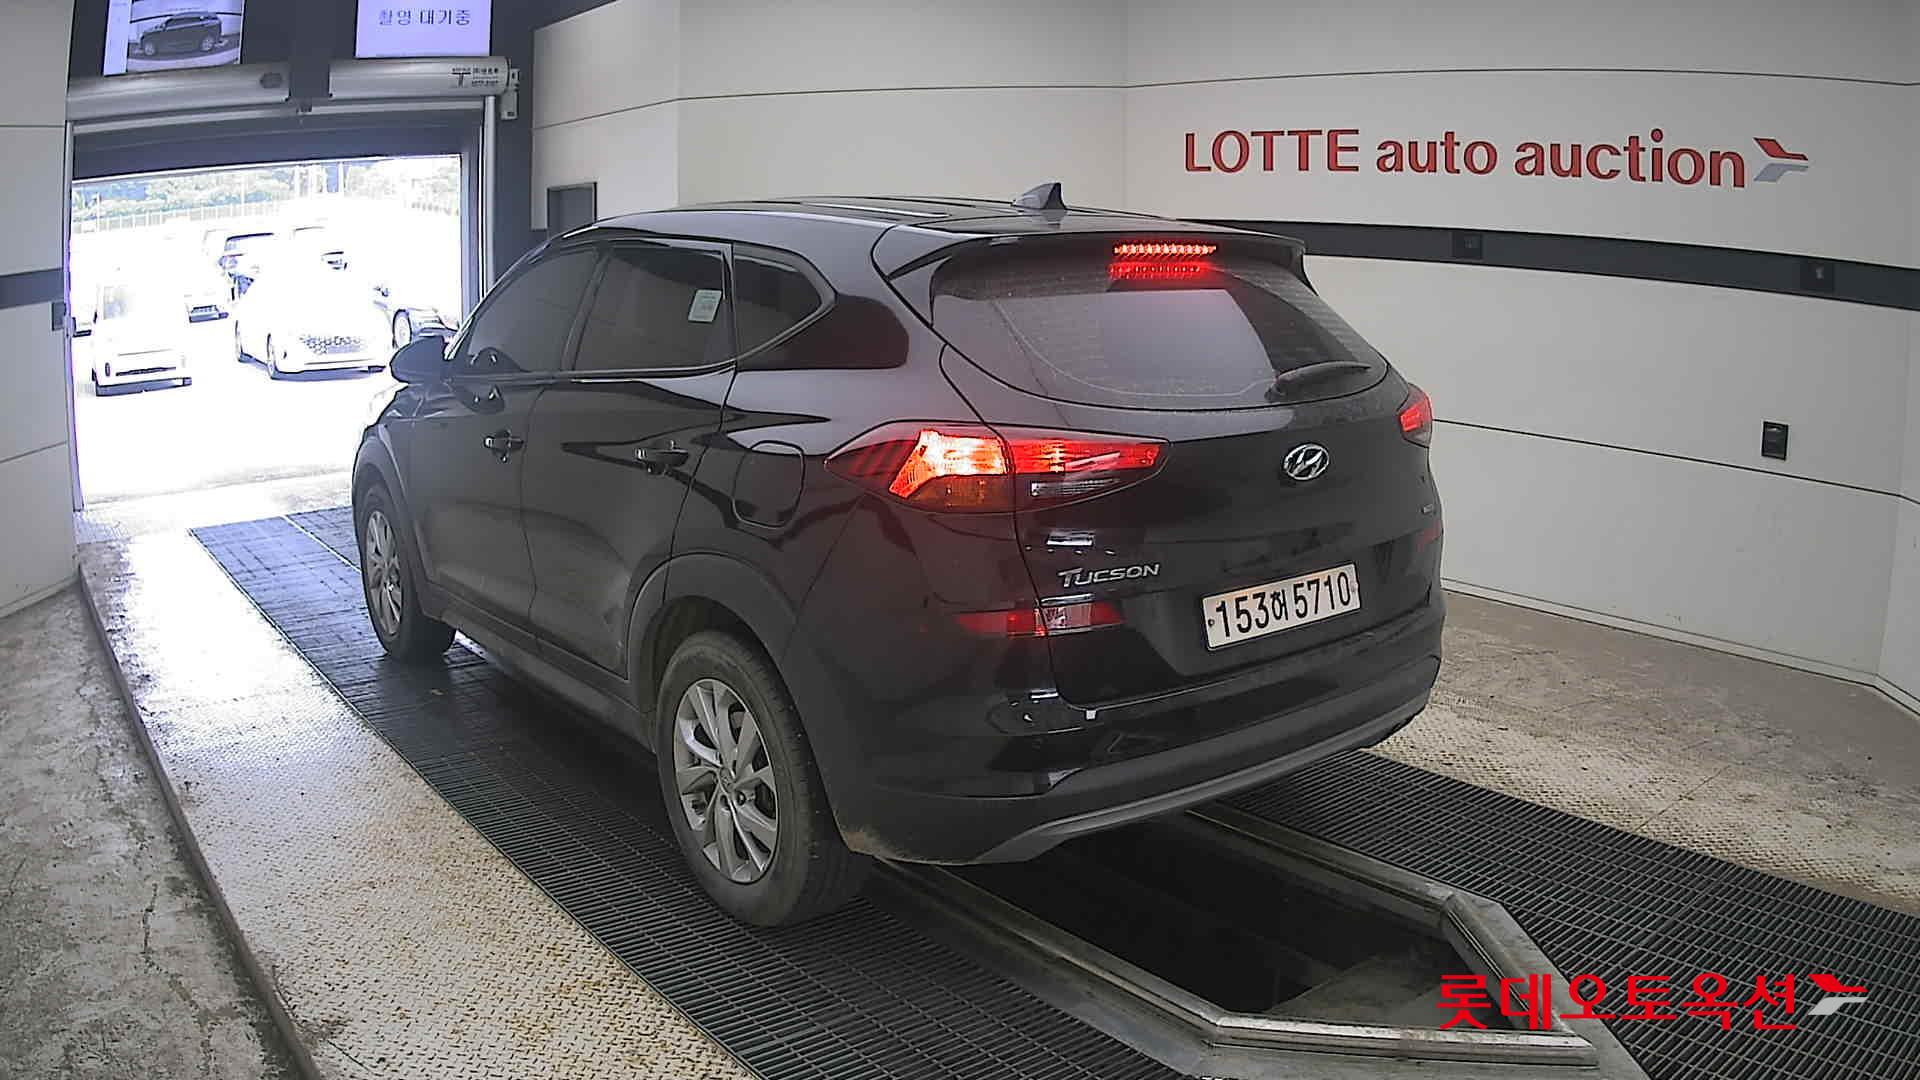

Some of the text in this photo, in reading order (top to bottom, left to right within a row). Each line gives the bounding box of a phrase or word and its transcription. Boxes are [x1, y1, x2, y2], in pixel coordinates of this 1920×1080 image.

[419, 9, 470, 26] 대기중
[1185, 128, 1745, 188] LOTTE auto auction
